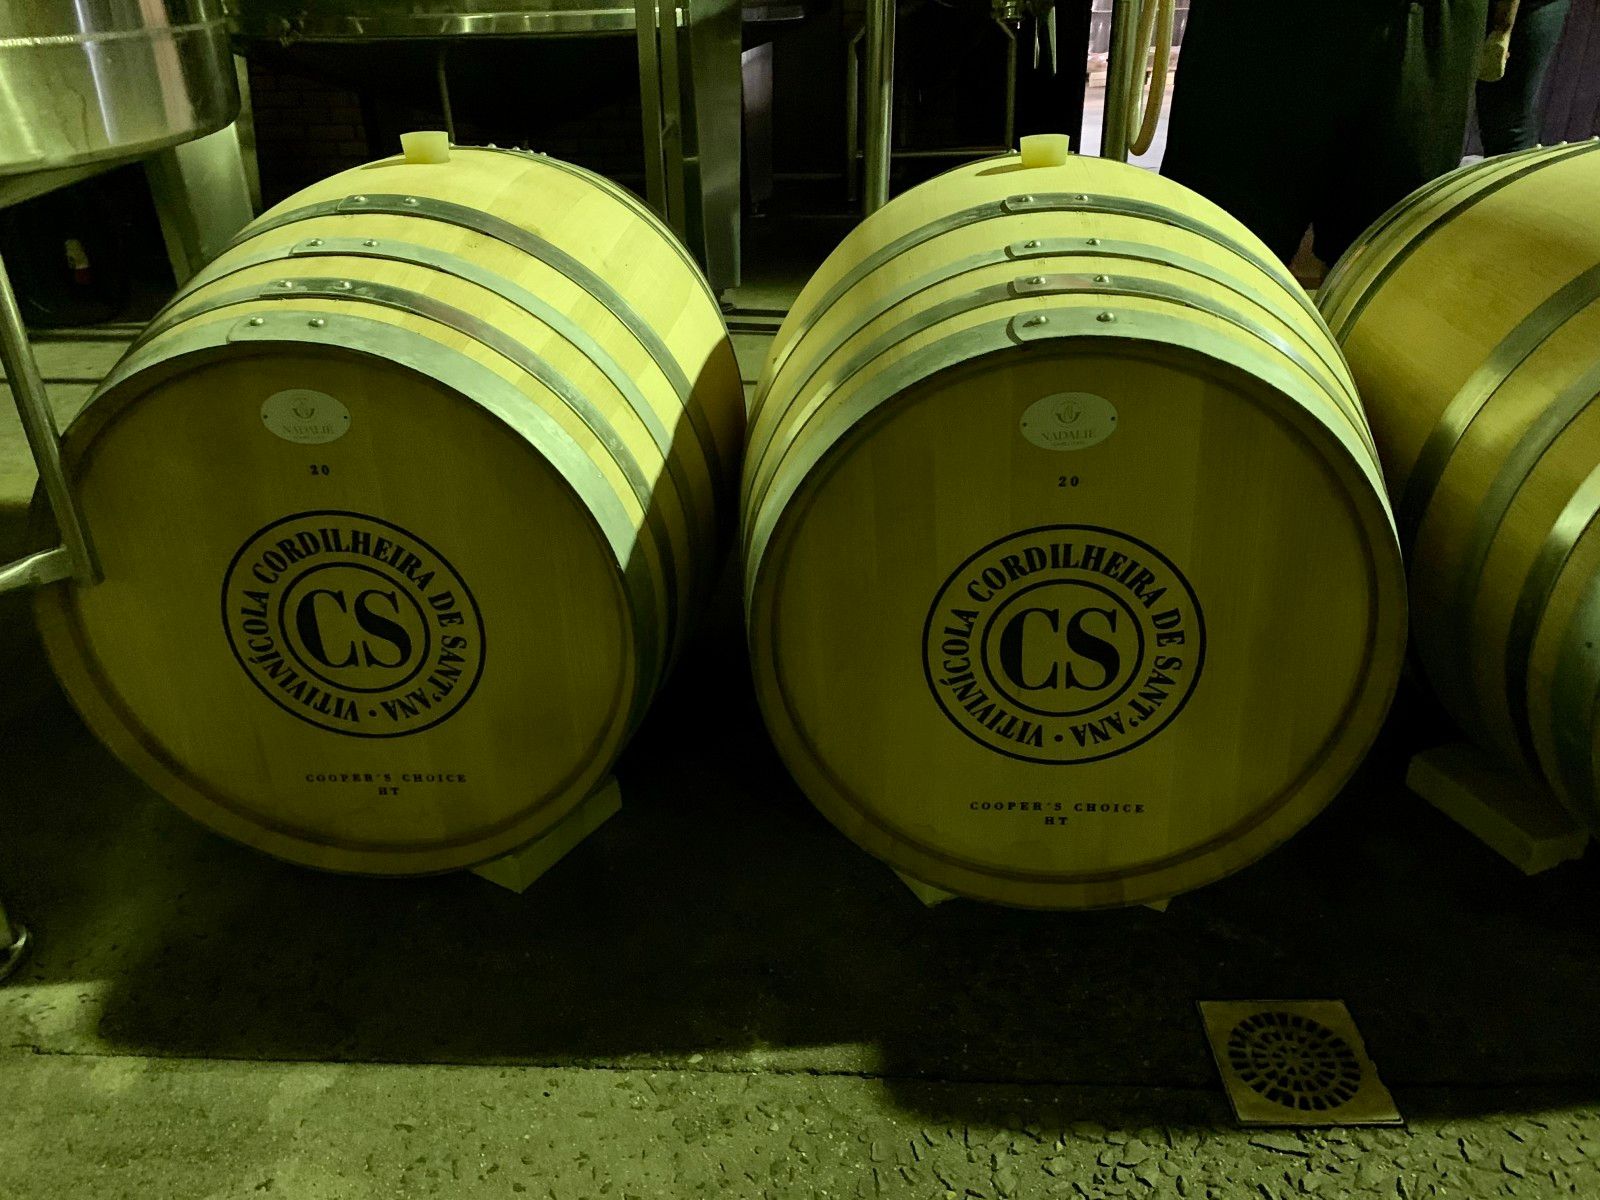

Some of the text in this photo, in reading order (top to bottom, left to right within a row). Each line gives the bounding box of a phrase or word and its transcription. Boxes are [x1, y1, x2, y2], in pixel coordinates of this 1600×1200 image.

[309, 464, 331, 476] 20
[1058, 475, 1080, 488] 20
[252, 528, 437, 592] CORDILHEIRA
[967, 543, 1168, 609] CORDILHEIRA
[427, 591, 465, 627] DE
[1151, 608, 1185, 648] DE
[295, 589, 412, 669] CS
[1000, 607, 1121, 691] CS
[381, 635, 467, 722] SANT'ANA
[1069, 655, 1183, 748] SANT'ANA
[305, 773, 467, 783] COOPER'S CHOICE
[378, 787, 400, 796] HT
[970, 801, 1145, 813] COOPER'S CHOICE
[1044, 816, 1068, 825] HT
